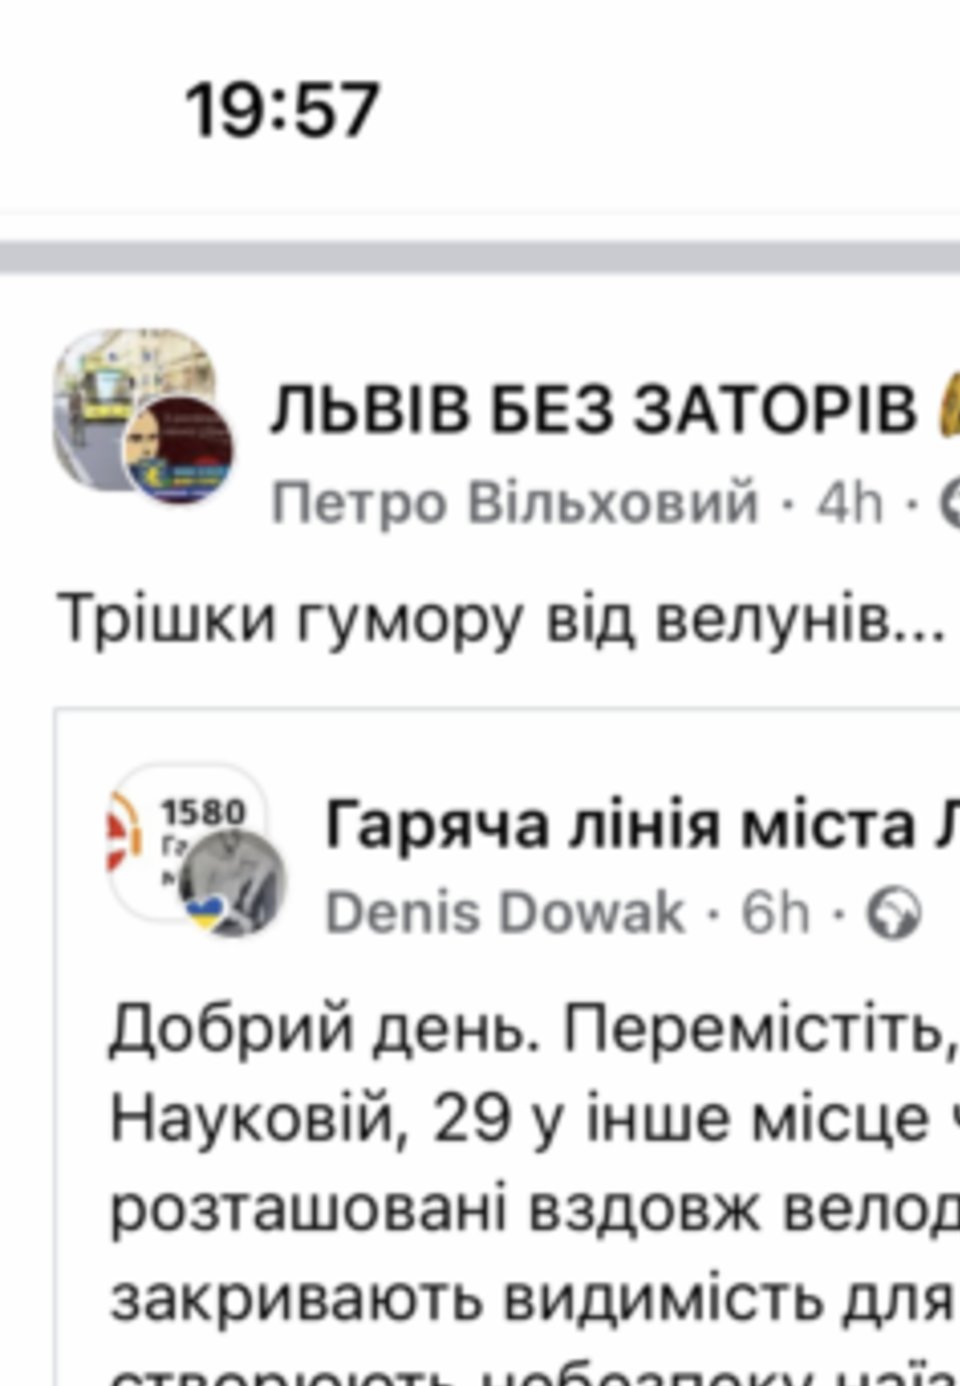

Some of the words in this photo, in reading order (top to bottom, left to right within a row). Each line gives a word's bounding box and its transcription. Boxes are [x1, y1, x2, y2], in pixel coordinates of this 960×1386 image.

[184, 79, 382, 140] 19:57
[268, 382, 472, 437] ЛЬВІВ
[491, 381, 615, 437] БЕЗ
[633, 381, 919, 437] ЗАТОРІВ
[272, 479, 448, 534] Петро
[468, 477, 758, 525] Вільховий
[817, 478, 883, 524] 4h
[55, 588, 276, 655] Трішки
[297, 602, 525, 656] гумору
[547, 588, 638, 652] від
[656, 588, 945, 656] велунів...
[161, 798, 246, 826] 1580
[326, 797, 550, 862] Гаряча
[567, 794, 721, 850] лінія
[741, 794, 916, 851] міста
[326, 887, 481, 935] Denis
[499, 887, 686, 935] Dowak
[742, 888, 809, 935] 6h
[107, 998, 353, 1064] Добрий
[372, 1013, 539, 1061] день.
[565, 999, 958, 1064] Перемістіть,
[112, 1087, 407, 1154] Науковій,
[434, 1090, 512, 1143] 29
[531, 1103, 565, 1154] у
[588, 1089, 731, 1142] інше
[753, 1089, 930, 1151] місце
[112, 1179, 506, 1243] розташовані
[530, 1192, 761, 1241] вздовж
[110, 1282, 484, 1333] закривають
[504, 1269, 825, 1331] видимість
[841, 1282, 954, 1331] для
